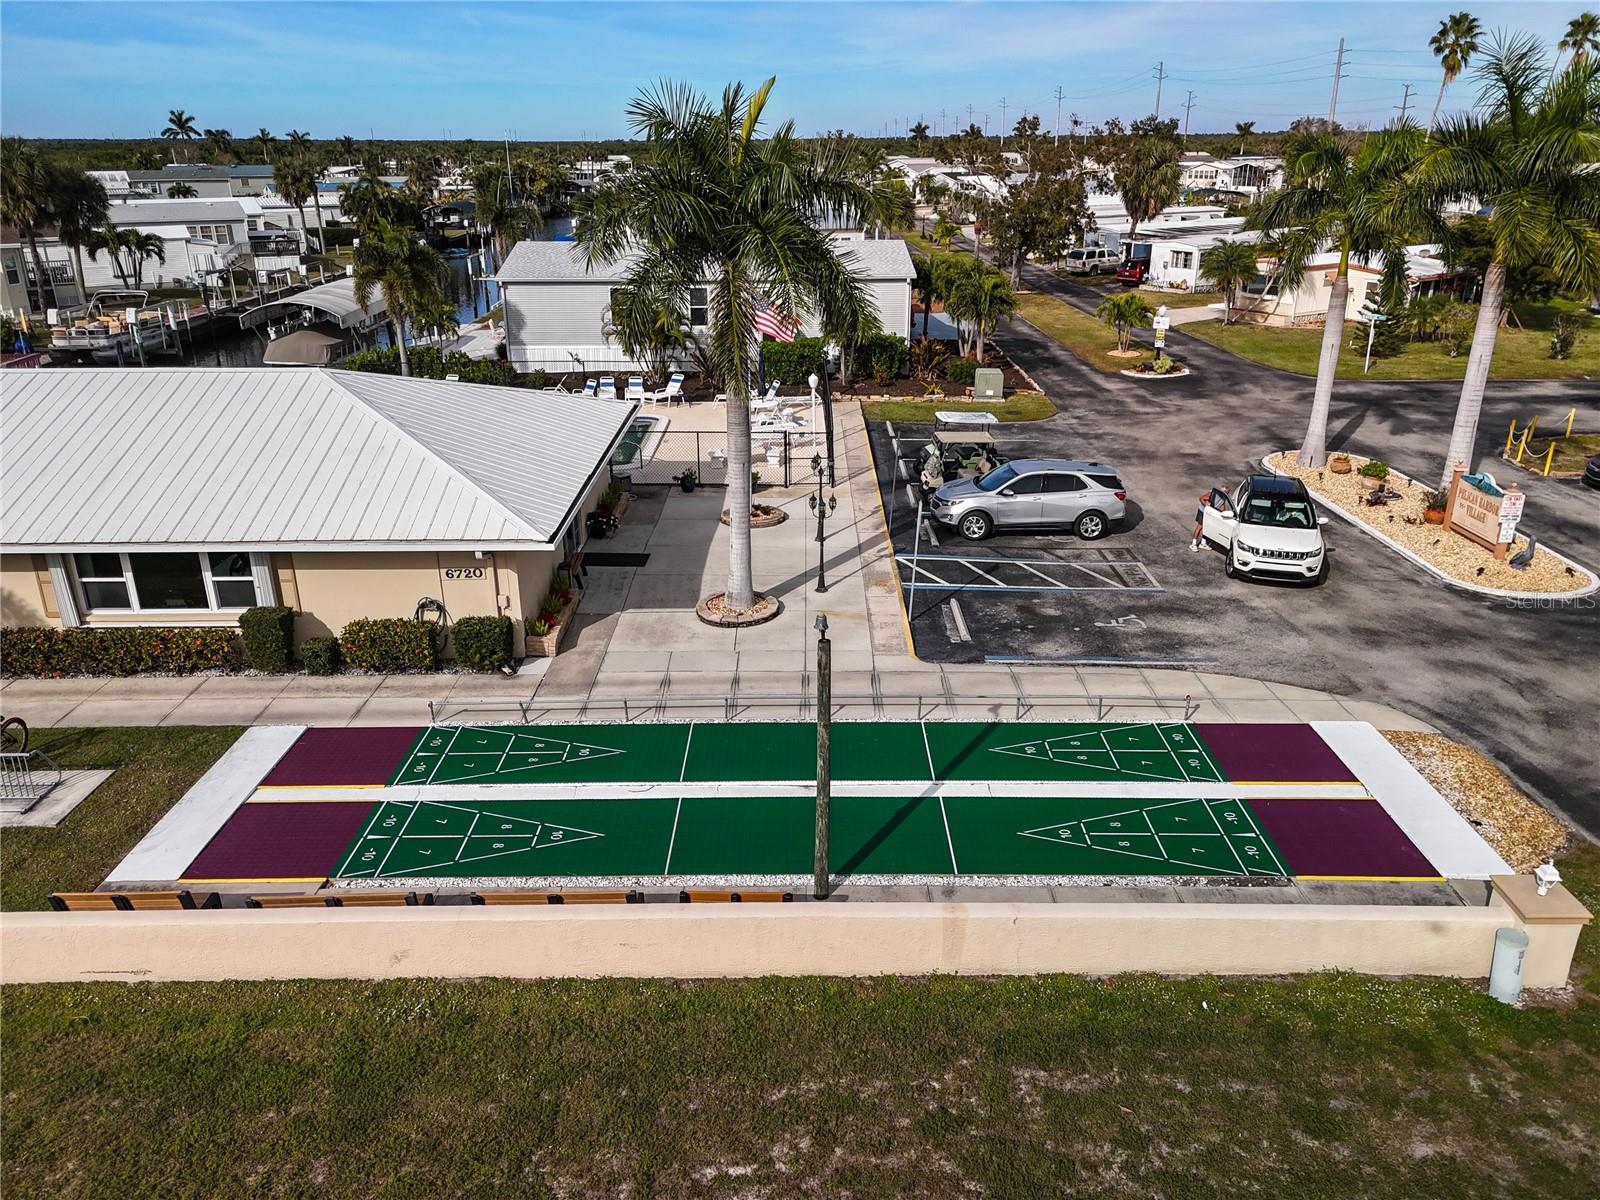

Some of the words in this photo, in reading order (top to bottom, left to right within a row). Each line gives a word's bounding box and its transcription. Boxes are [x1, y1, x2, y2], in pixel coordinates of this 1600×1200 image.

[1458, 487, 1479, 507] PELICAN
[1478, 497, 1500, 516] HARBOR
[1466, 504, 1487, 523] VILLAGE
[445, 568, 483, 579] 6720
[578, 748, 590, 756] 10
[1024, 746, 1037, 754] 10
[550, 830, 564, 841] 10
[1058, 828, 1072, 839] 10
